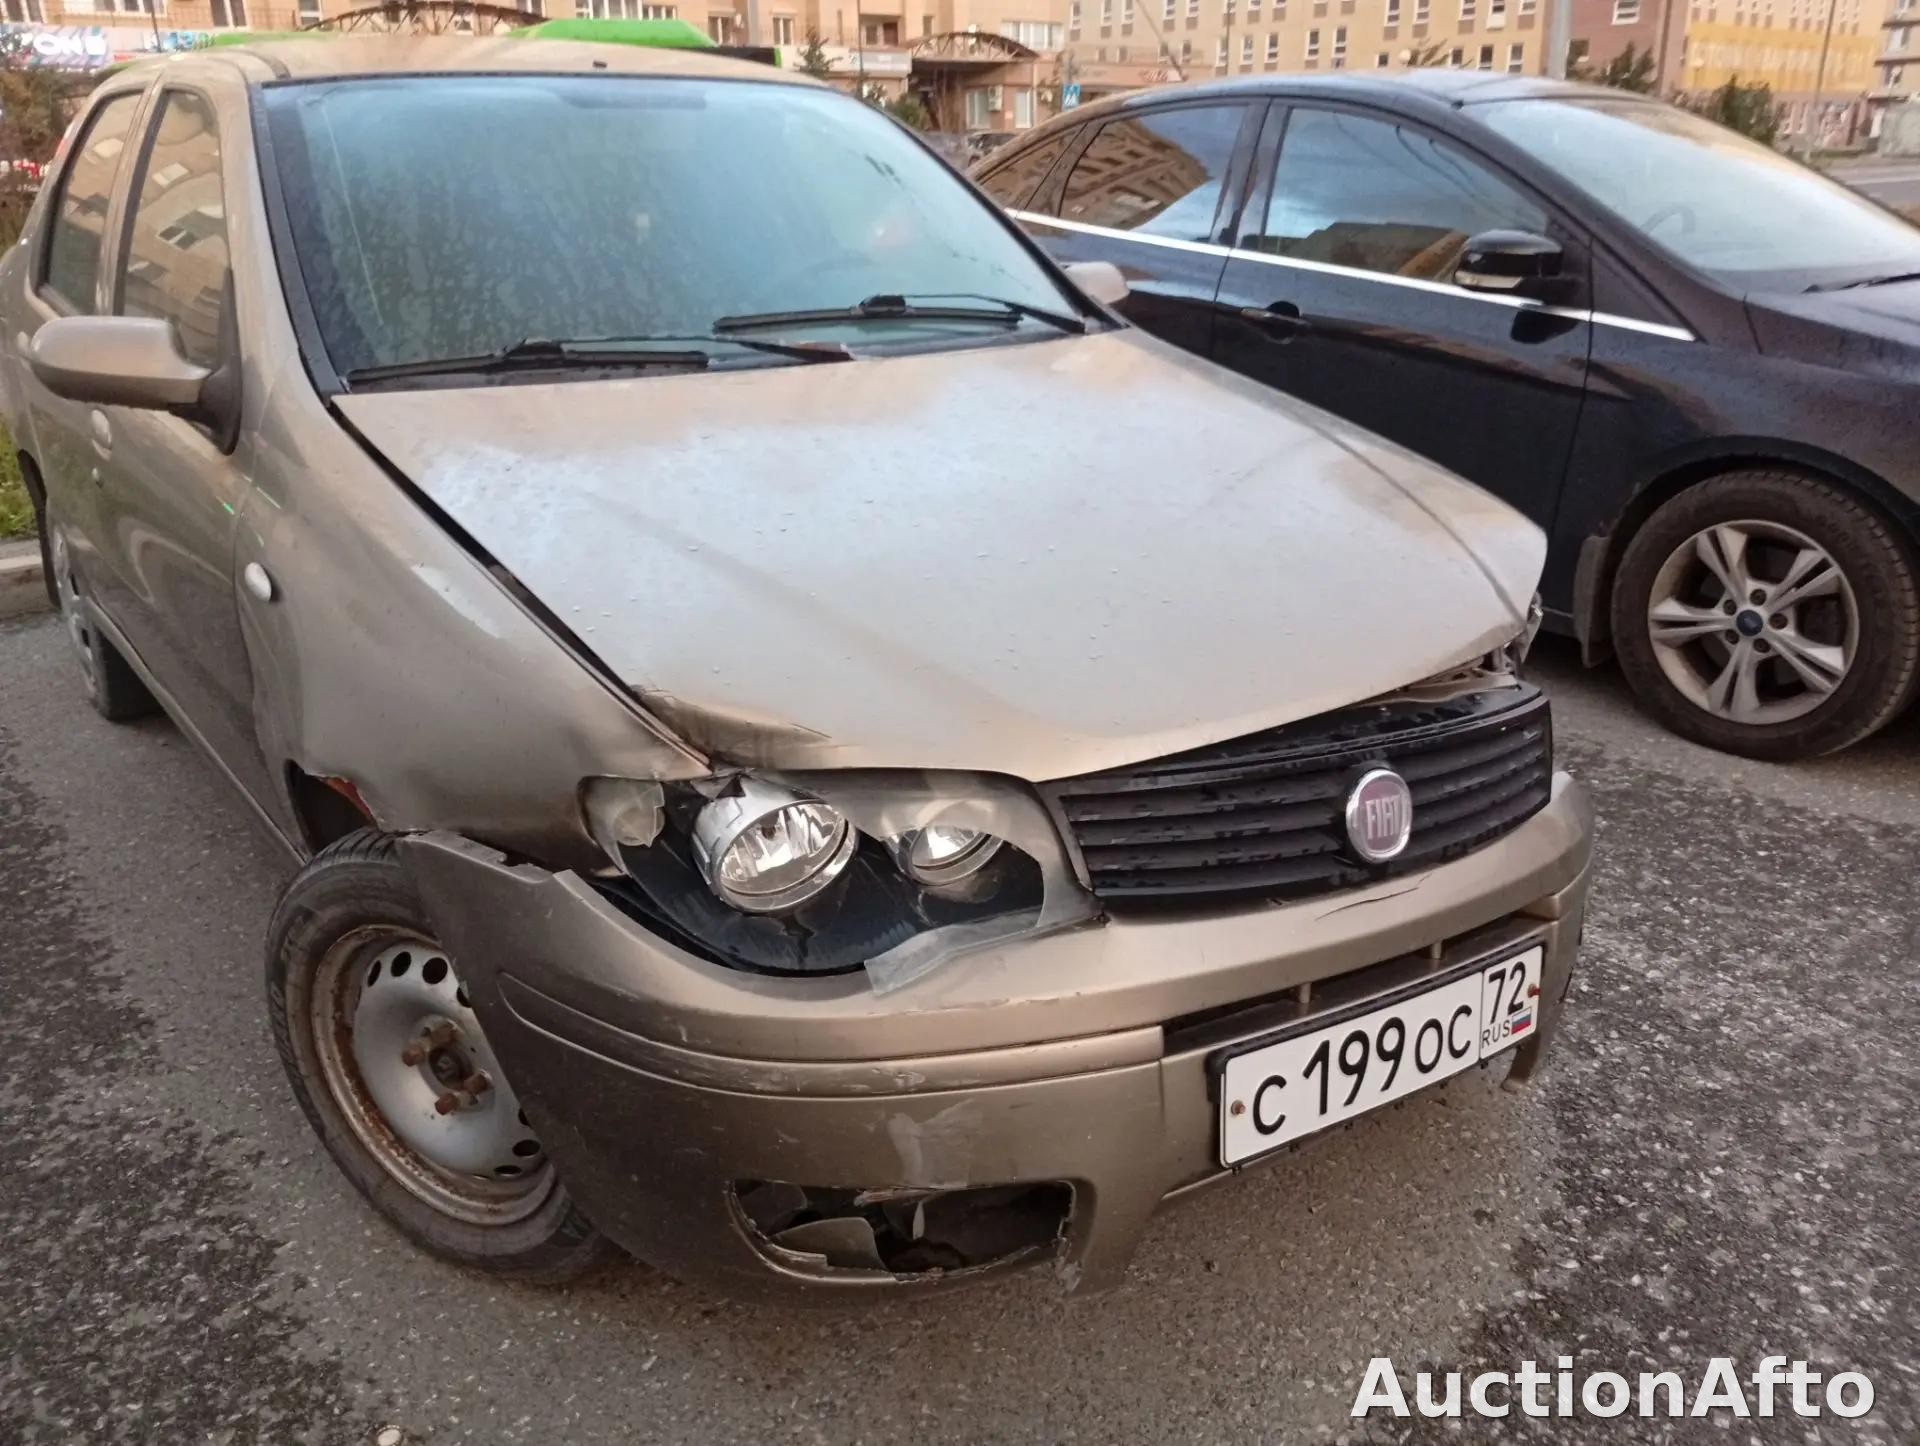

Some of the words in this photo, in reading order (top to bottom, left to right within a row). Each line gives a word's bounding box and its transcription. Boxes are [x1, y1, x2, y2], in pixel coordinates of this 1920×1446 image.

[1365, 794, 1401, 840] FIAT
[1489, 961, 1526, 1025] 72
[1481, 1019, 1510, 1048] RUS
